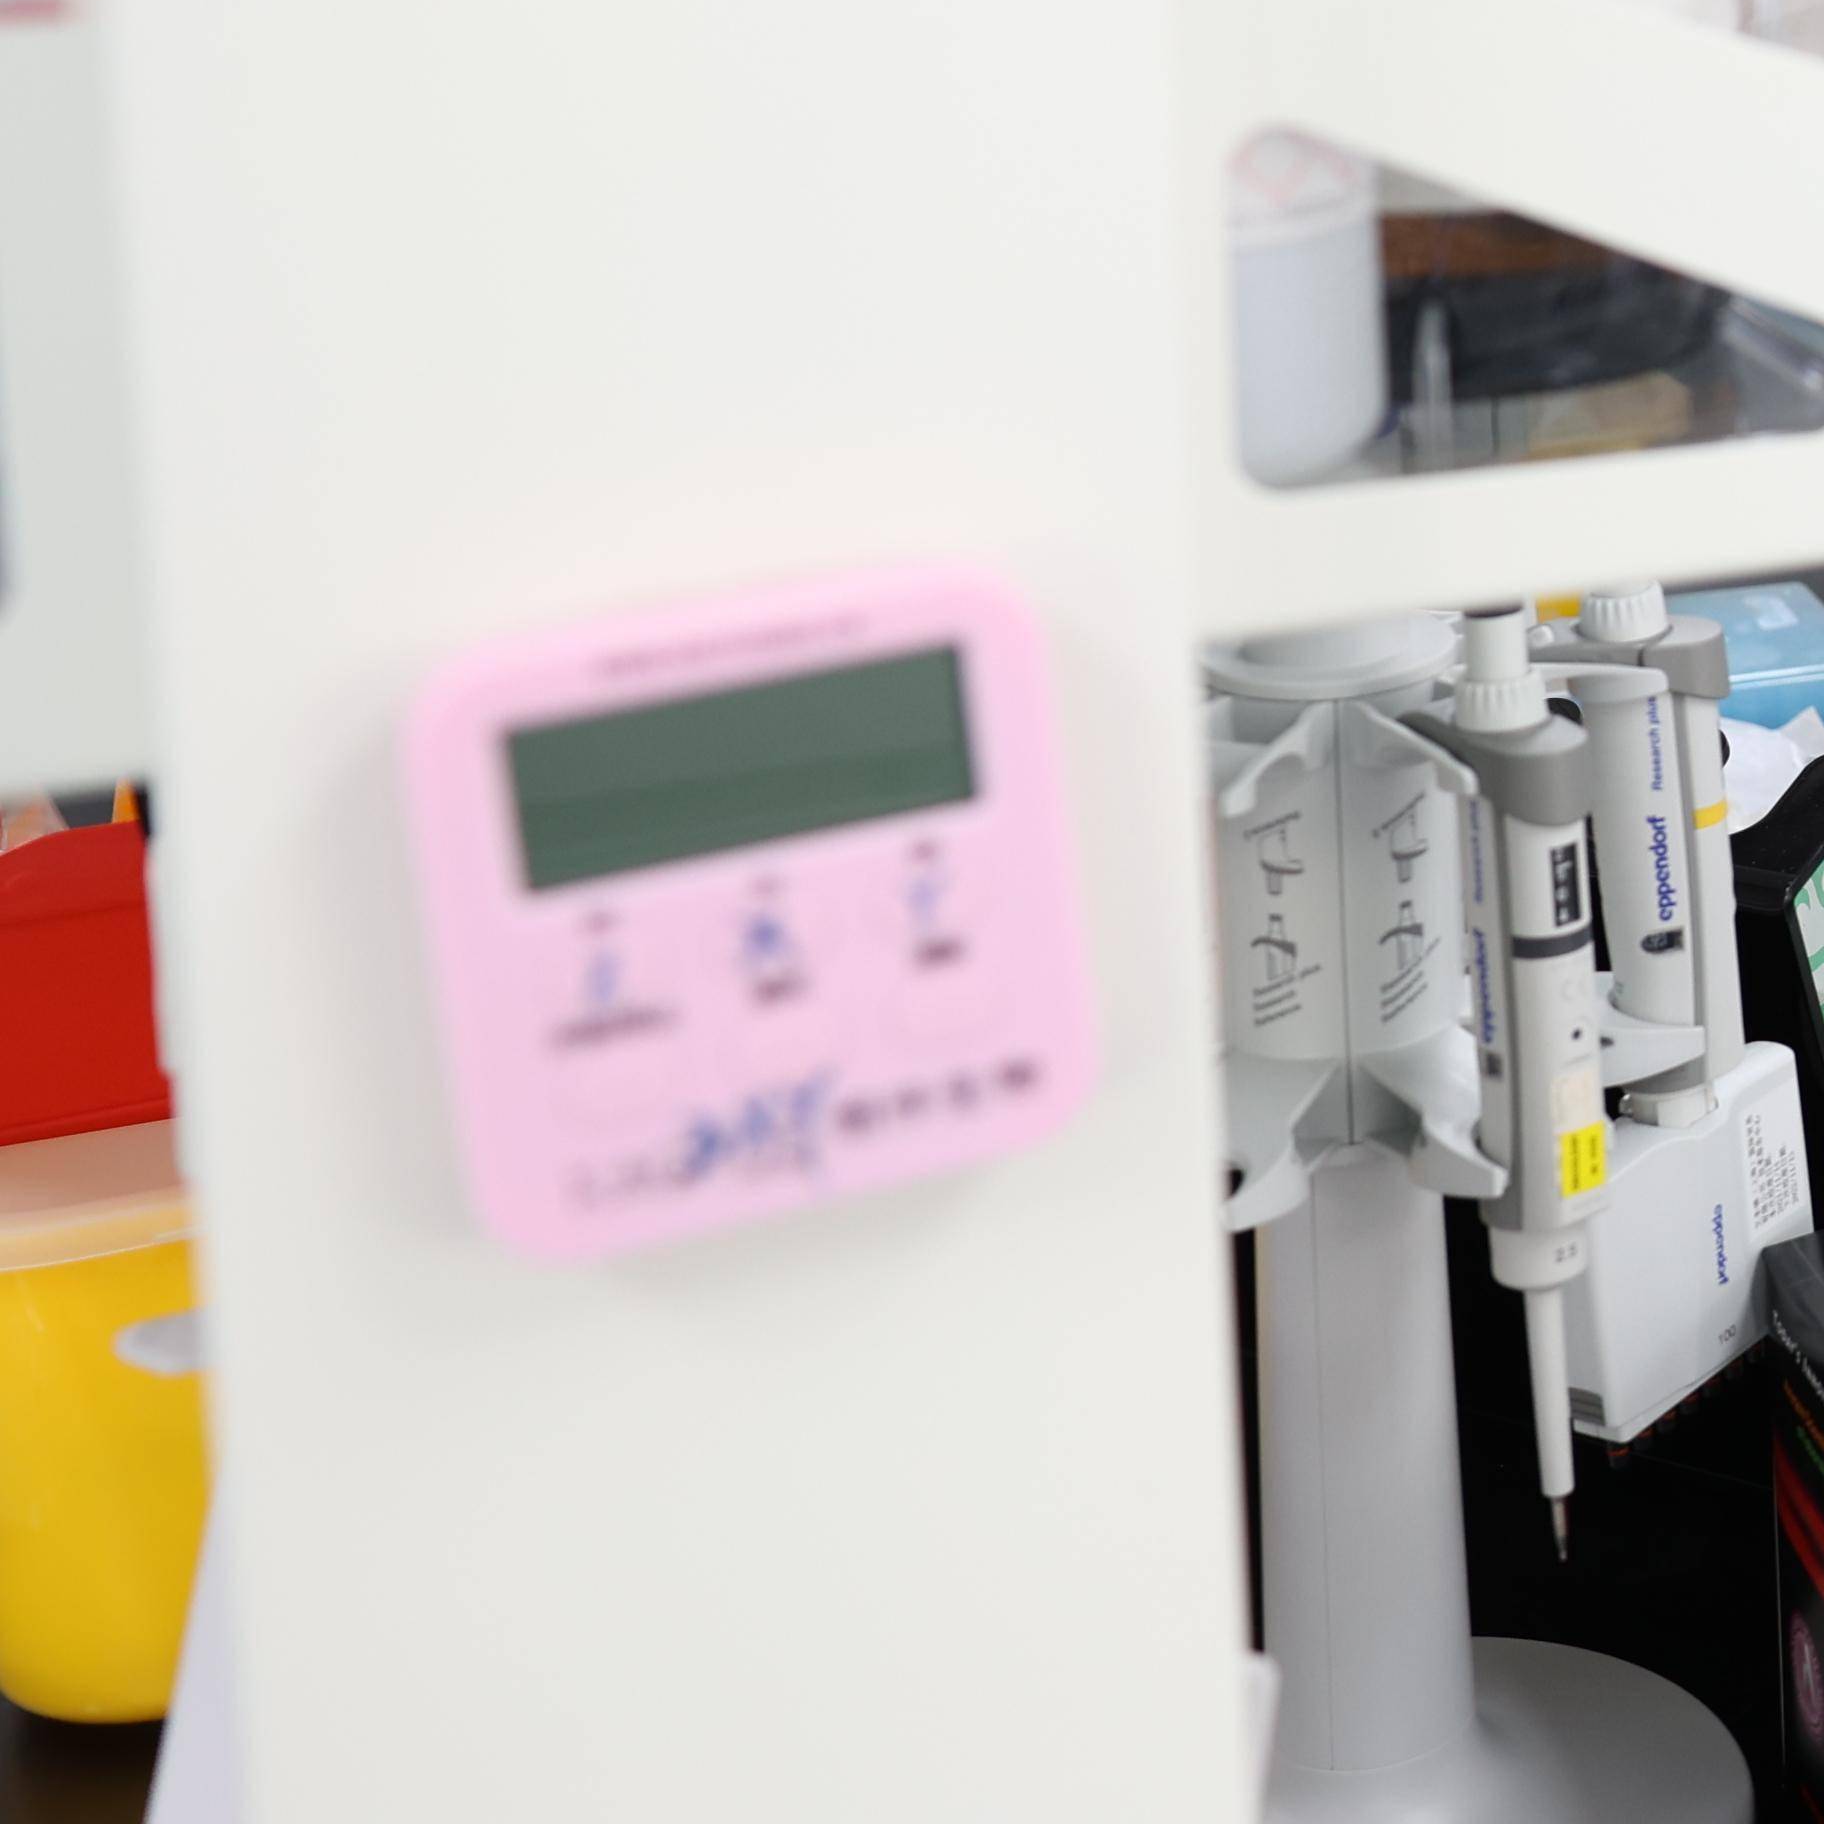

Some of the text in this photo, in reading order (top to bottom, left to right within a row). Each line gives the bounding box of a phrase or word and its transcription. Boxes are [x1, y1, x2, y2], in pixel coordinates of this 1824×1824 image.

[1648, 728, 1663, 791] Research
[1646, 815, 1677, 922] eppendorf
[1713, 1204, 1729, 1285] eppendorf
